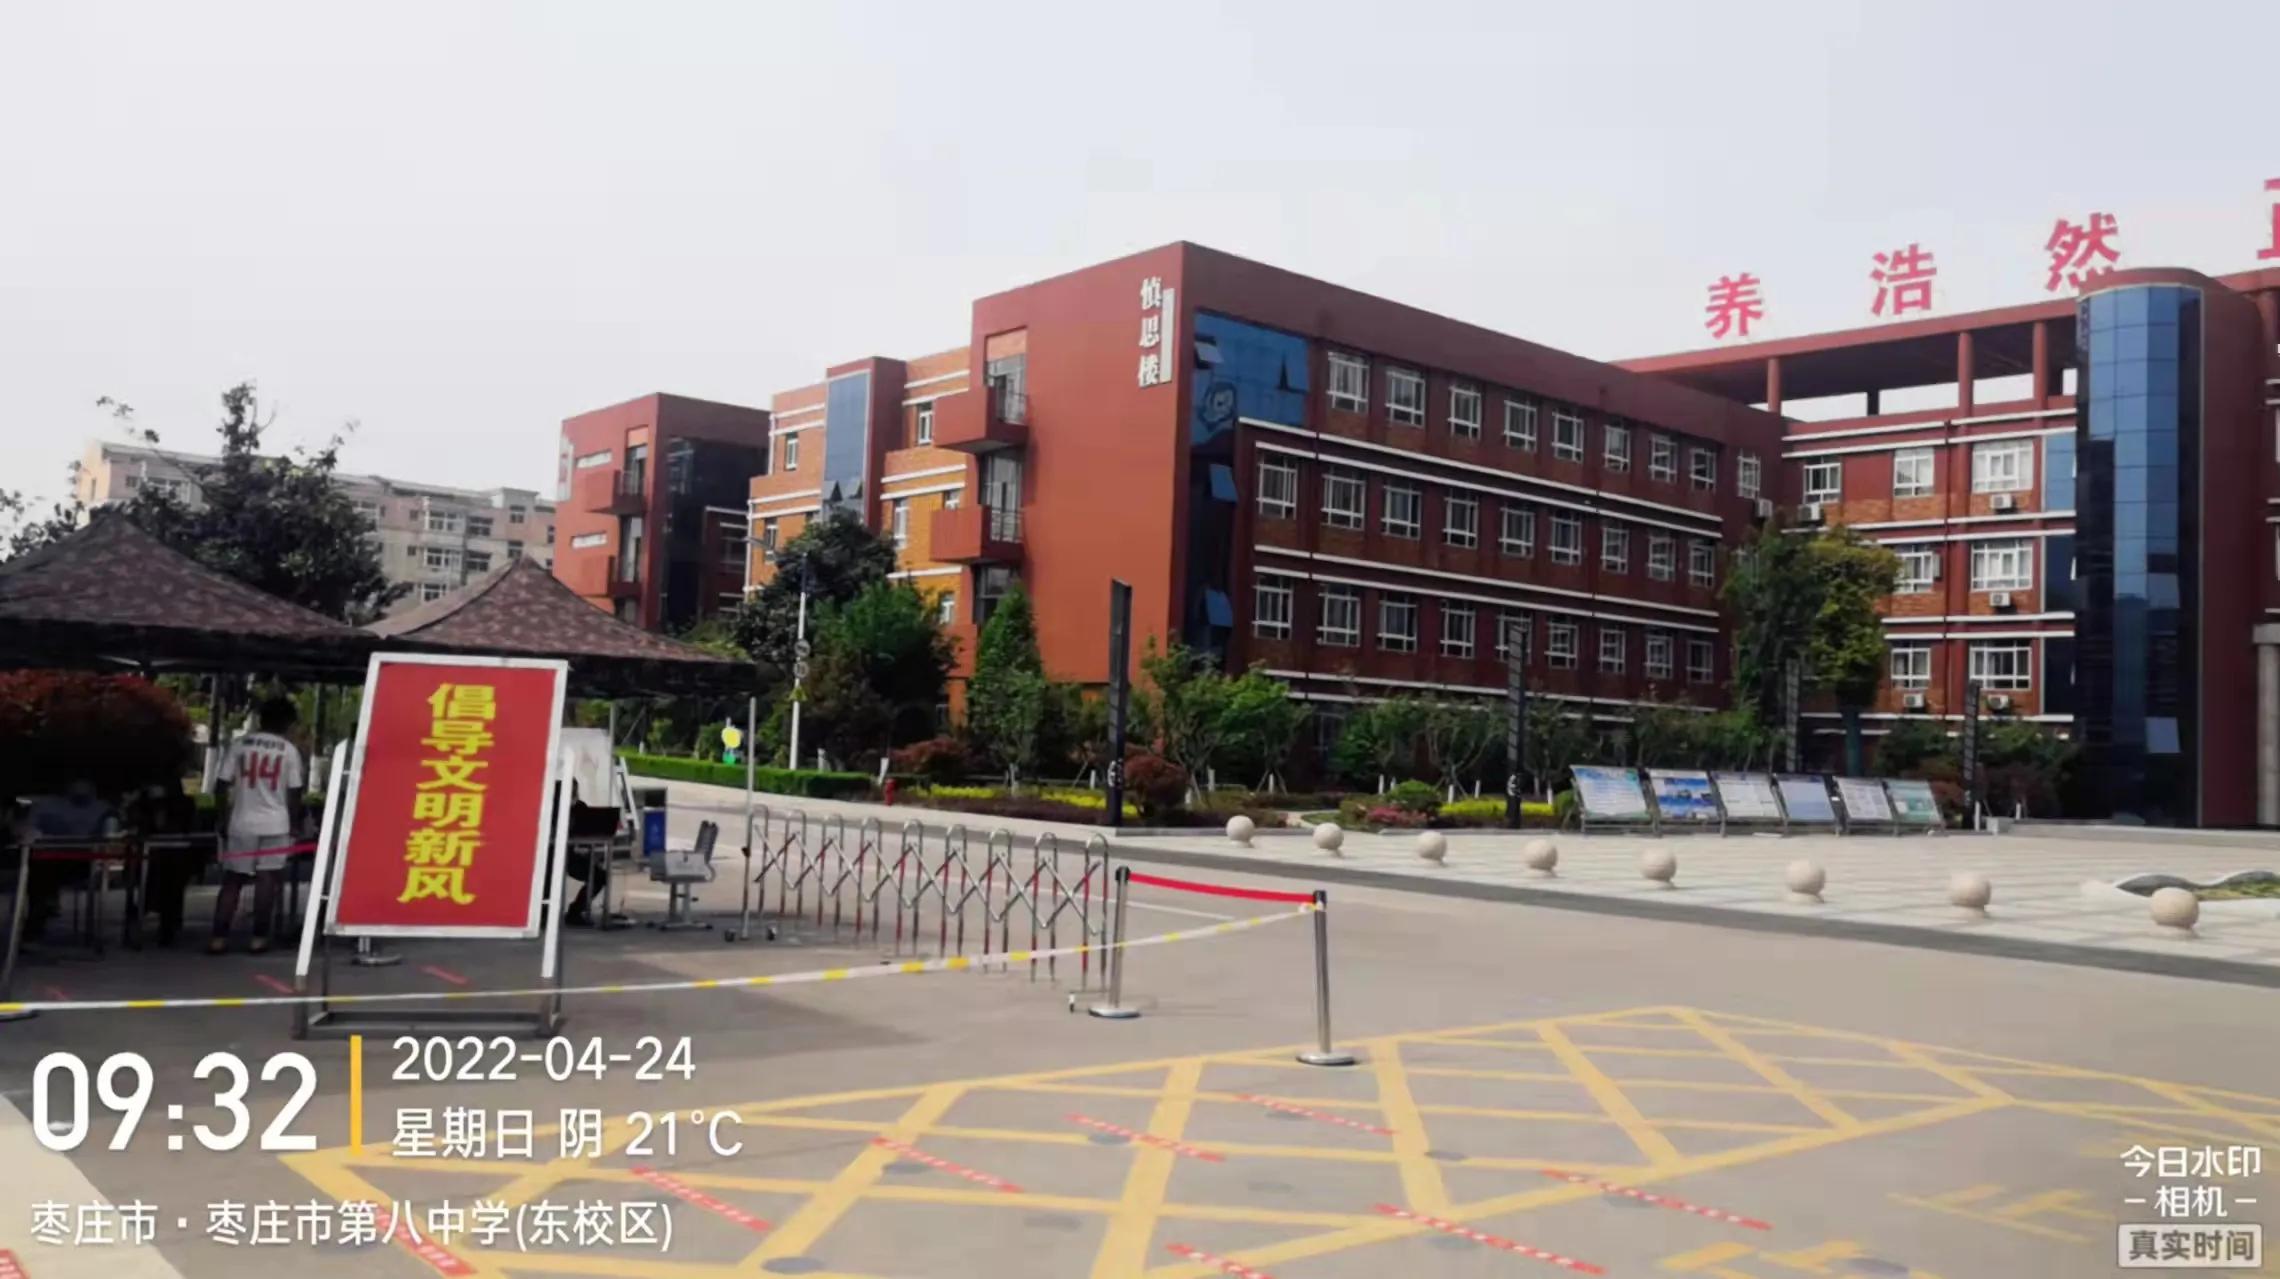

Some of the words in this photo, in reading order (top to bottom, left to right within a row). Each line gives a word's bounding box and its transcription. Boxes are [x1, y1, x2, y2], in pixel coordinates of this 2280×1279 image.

[240, 751, 283, 791] 44
[397, 683, 496, 905] 倡导文明新风
